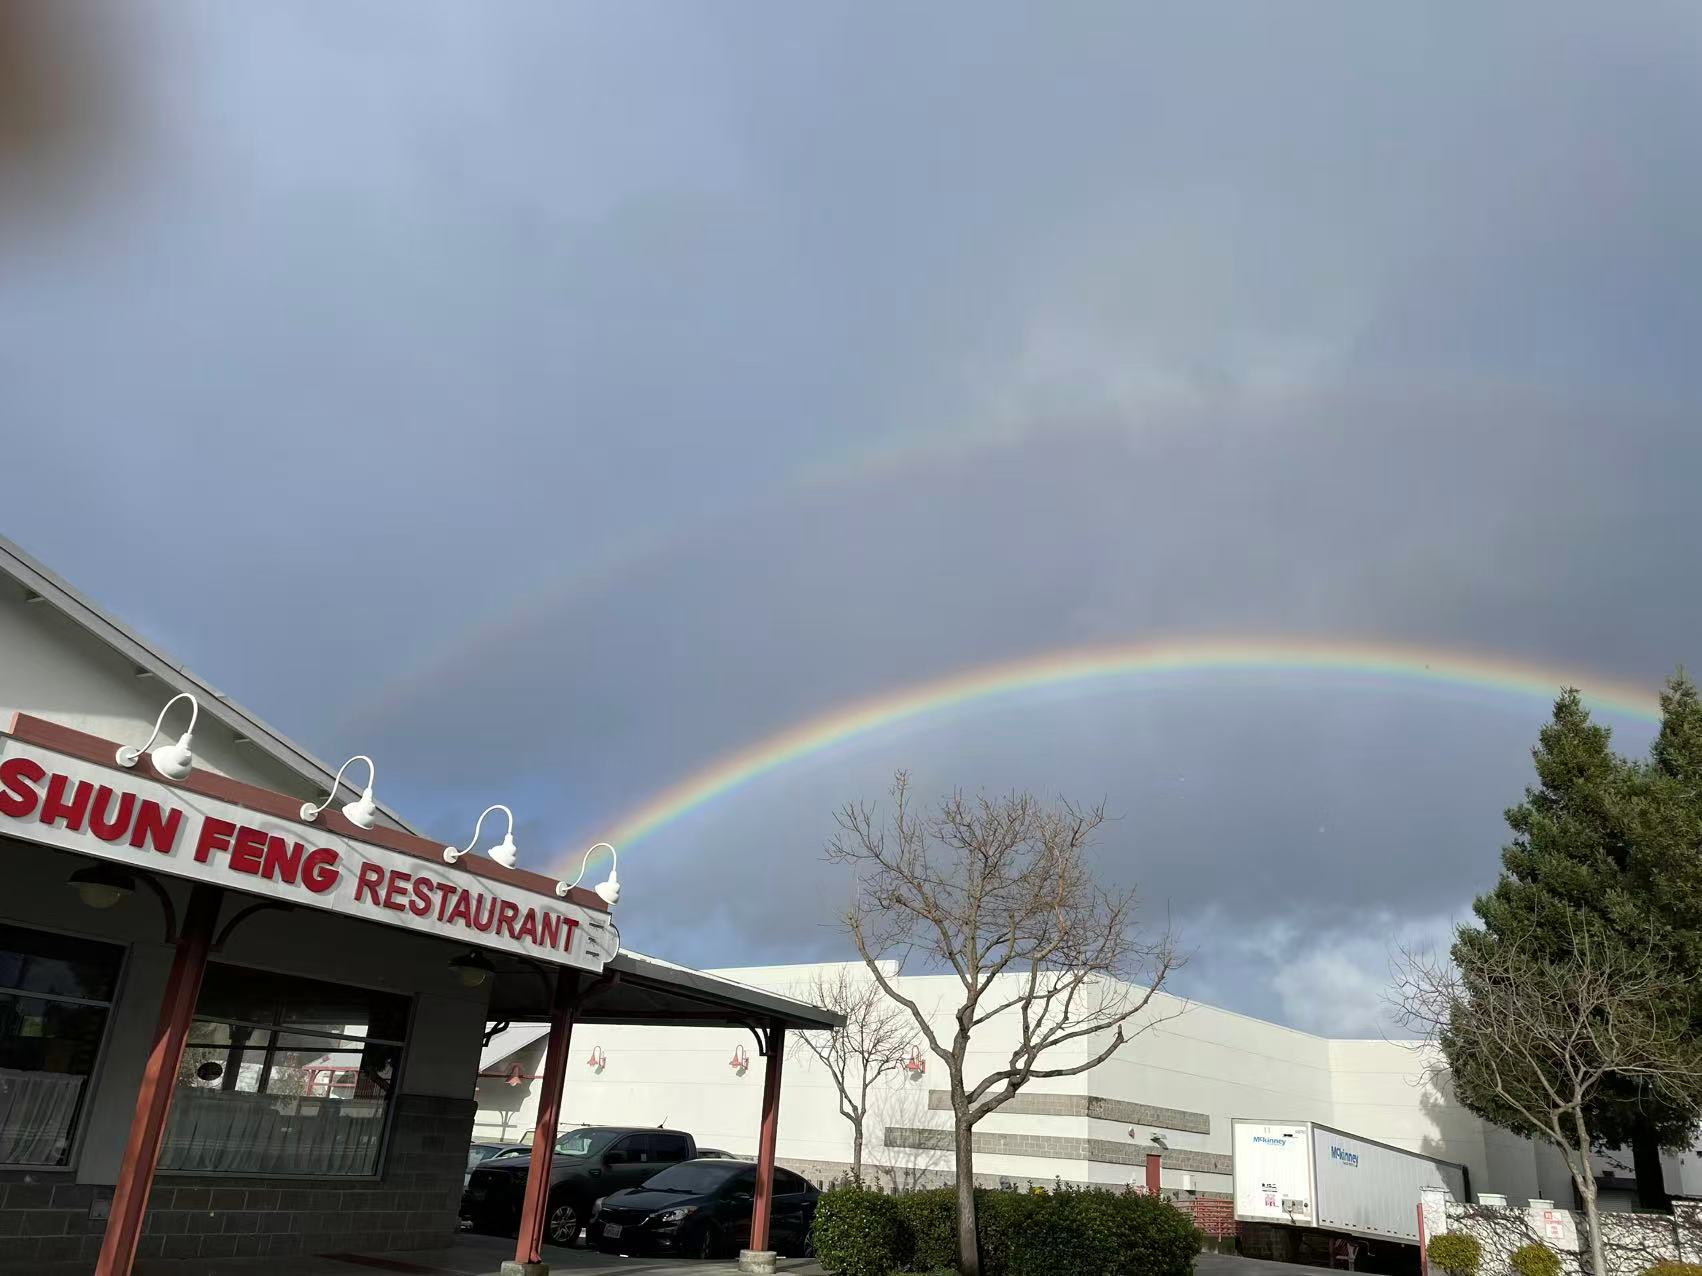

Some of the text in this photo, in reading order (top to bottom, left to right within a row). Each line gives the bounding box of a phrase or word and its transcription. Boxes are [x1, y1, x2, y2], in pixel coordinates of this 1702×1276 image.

[0, 758, 579, 952] SHUN FENG RESTAURANT
